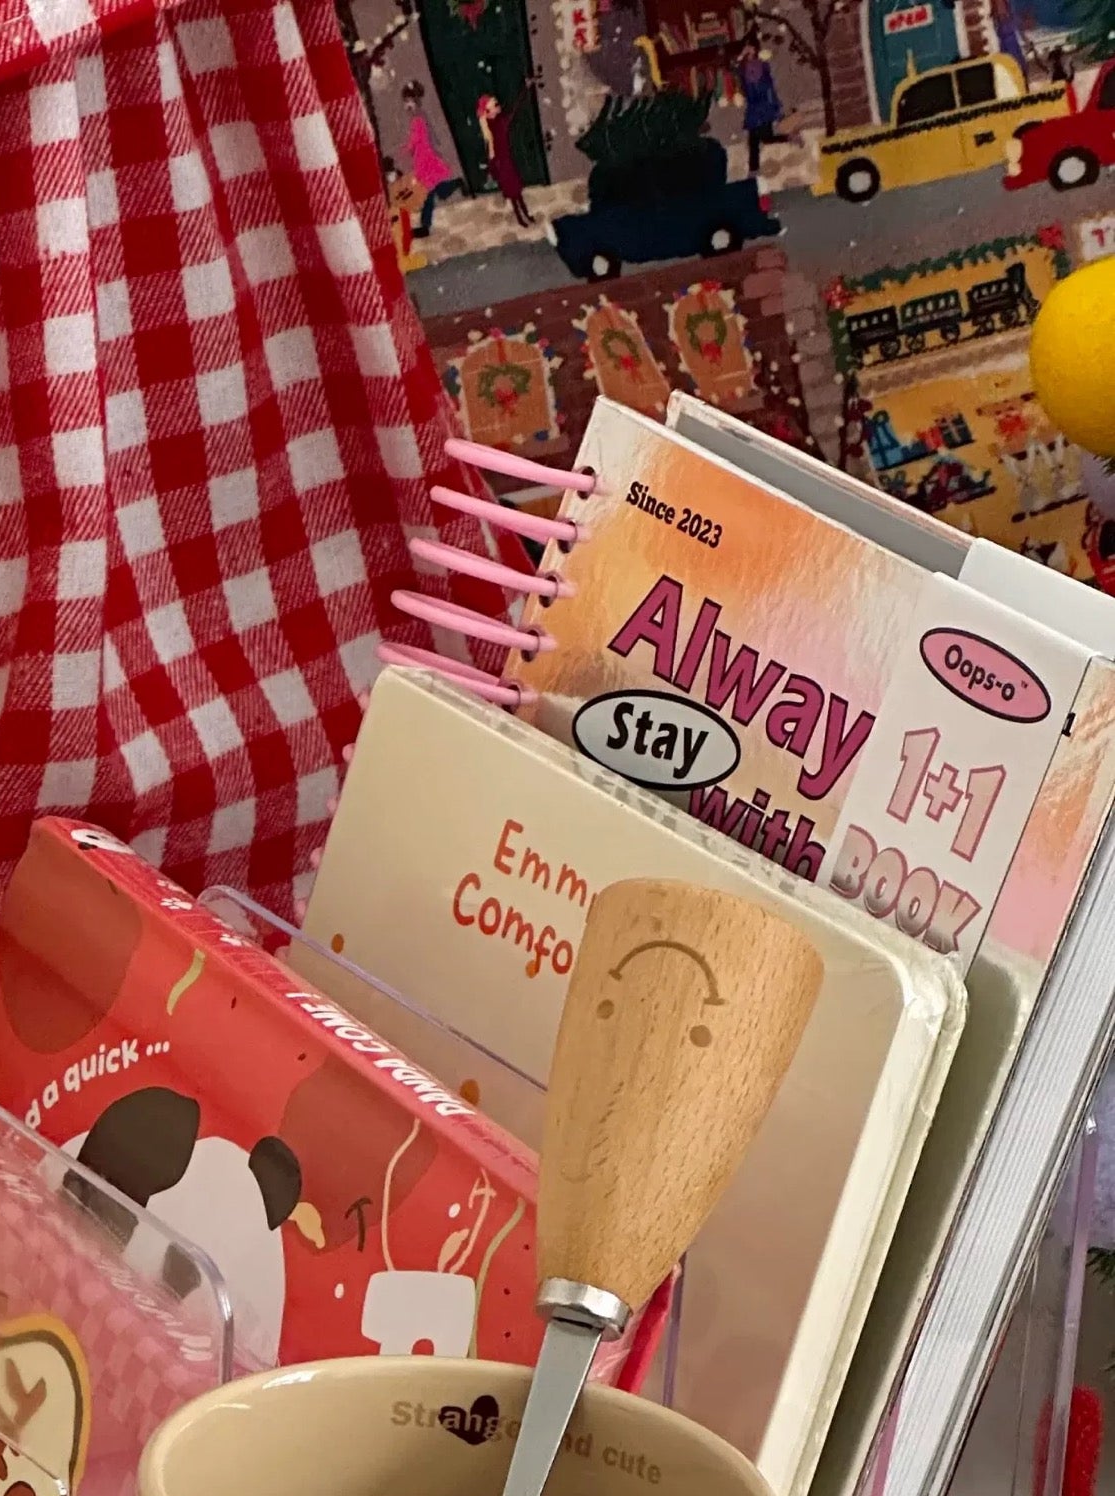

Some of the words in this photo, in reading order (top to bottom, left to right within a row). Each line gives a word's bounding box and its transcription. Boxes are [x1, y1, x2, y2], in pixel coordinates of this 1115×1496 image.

[626, 481, 676, 525] Since
[677, 508, 723, 549] 2023
[607, 574, 876, 801] Alway
[944, 644, 1016, 701] Oops-o
[606, 702, 709, 779] Stay
[887, 727, 1006, 863] 1+1
[494, 819, 597, 924] Emm
[688, 787, 827, 883] with
[829, 823, 982, 954] BOOK
[43, 1079, 59, 1109] a
[64, 1038, 139, 1092] quick
[373, 1058, 477, 1117] PANDA
[602, 1445, 662, 1485] cute
